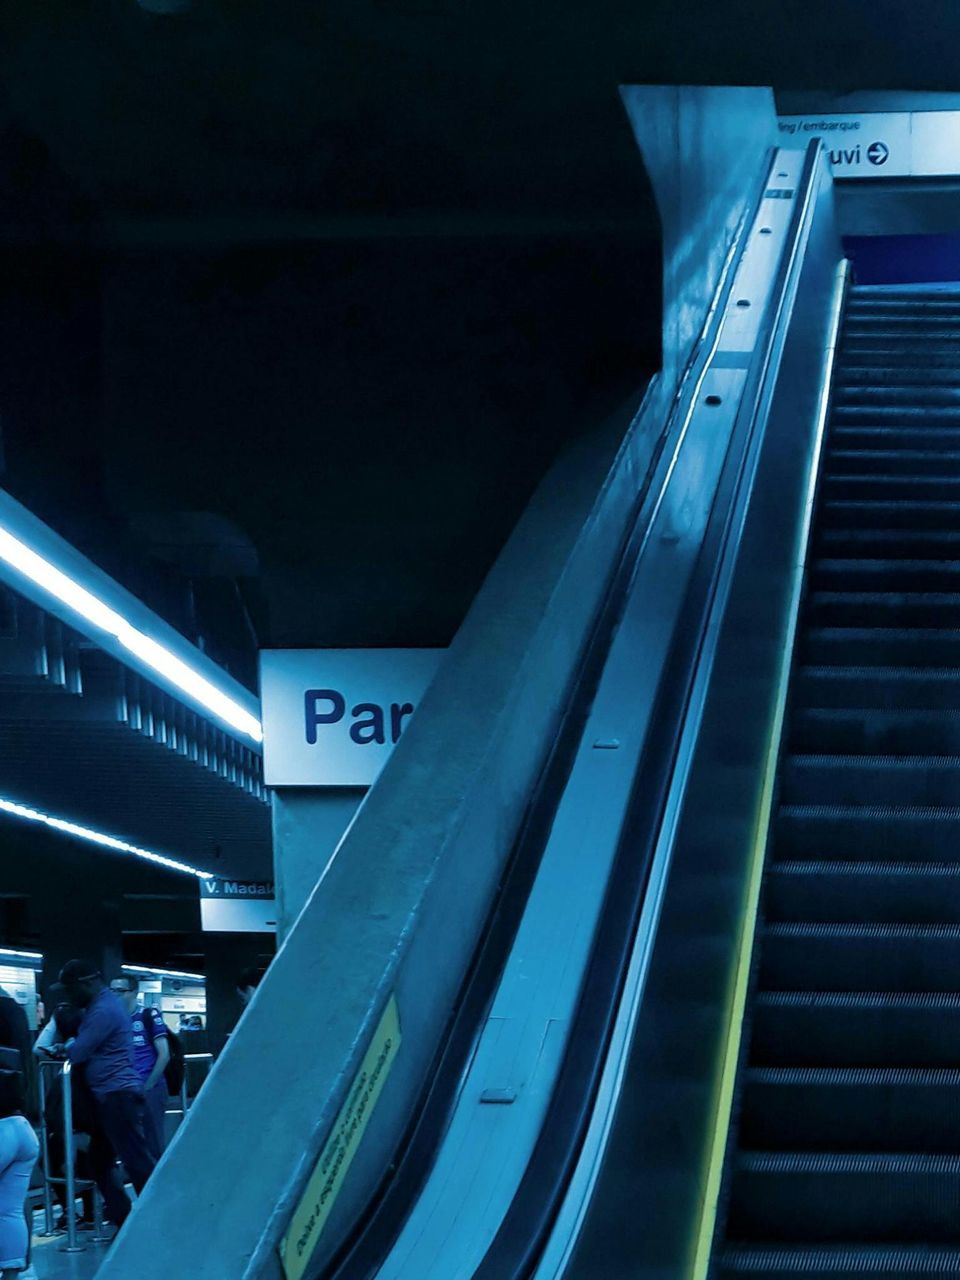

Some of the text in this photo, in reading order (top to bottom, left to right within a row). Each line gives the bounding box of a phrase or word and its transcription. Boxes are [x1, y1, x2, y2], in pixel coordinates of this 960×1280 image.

[803, 121, 861, 132] embarque
[304, 688, 414, 745] Par
[205, 881, 220, 894] V.
